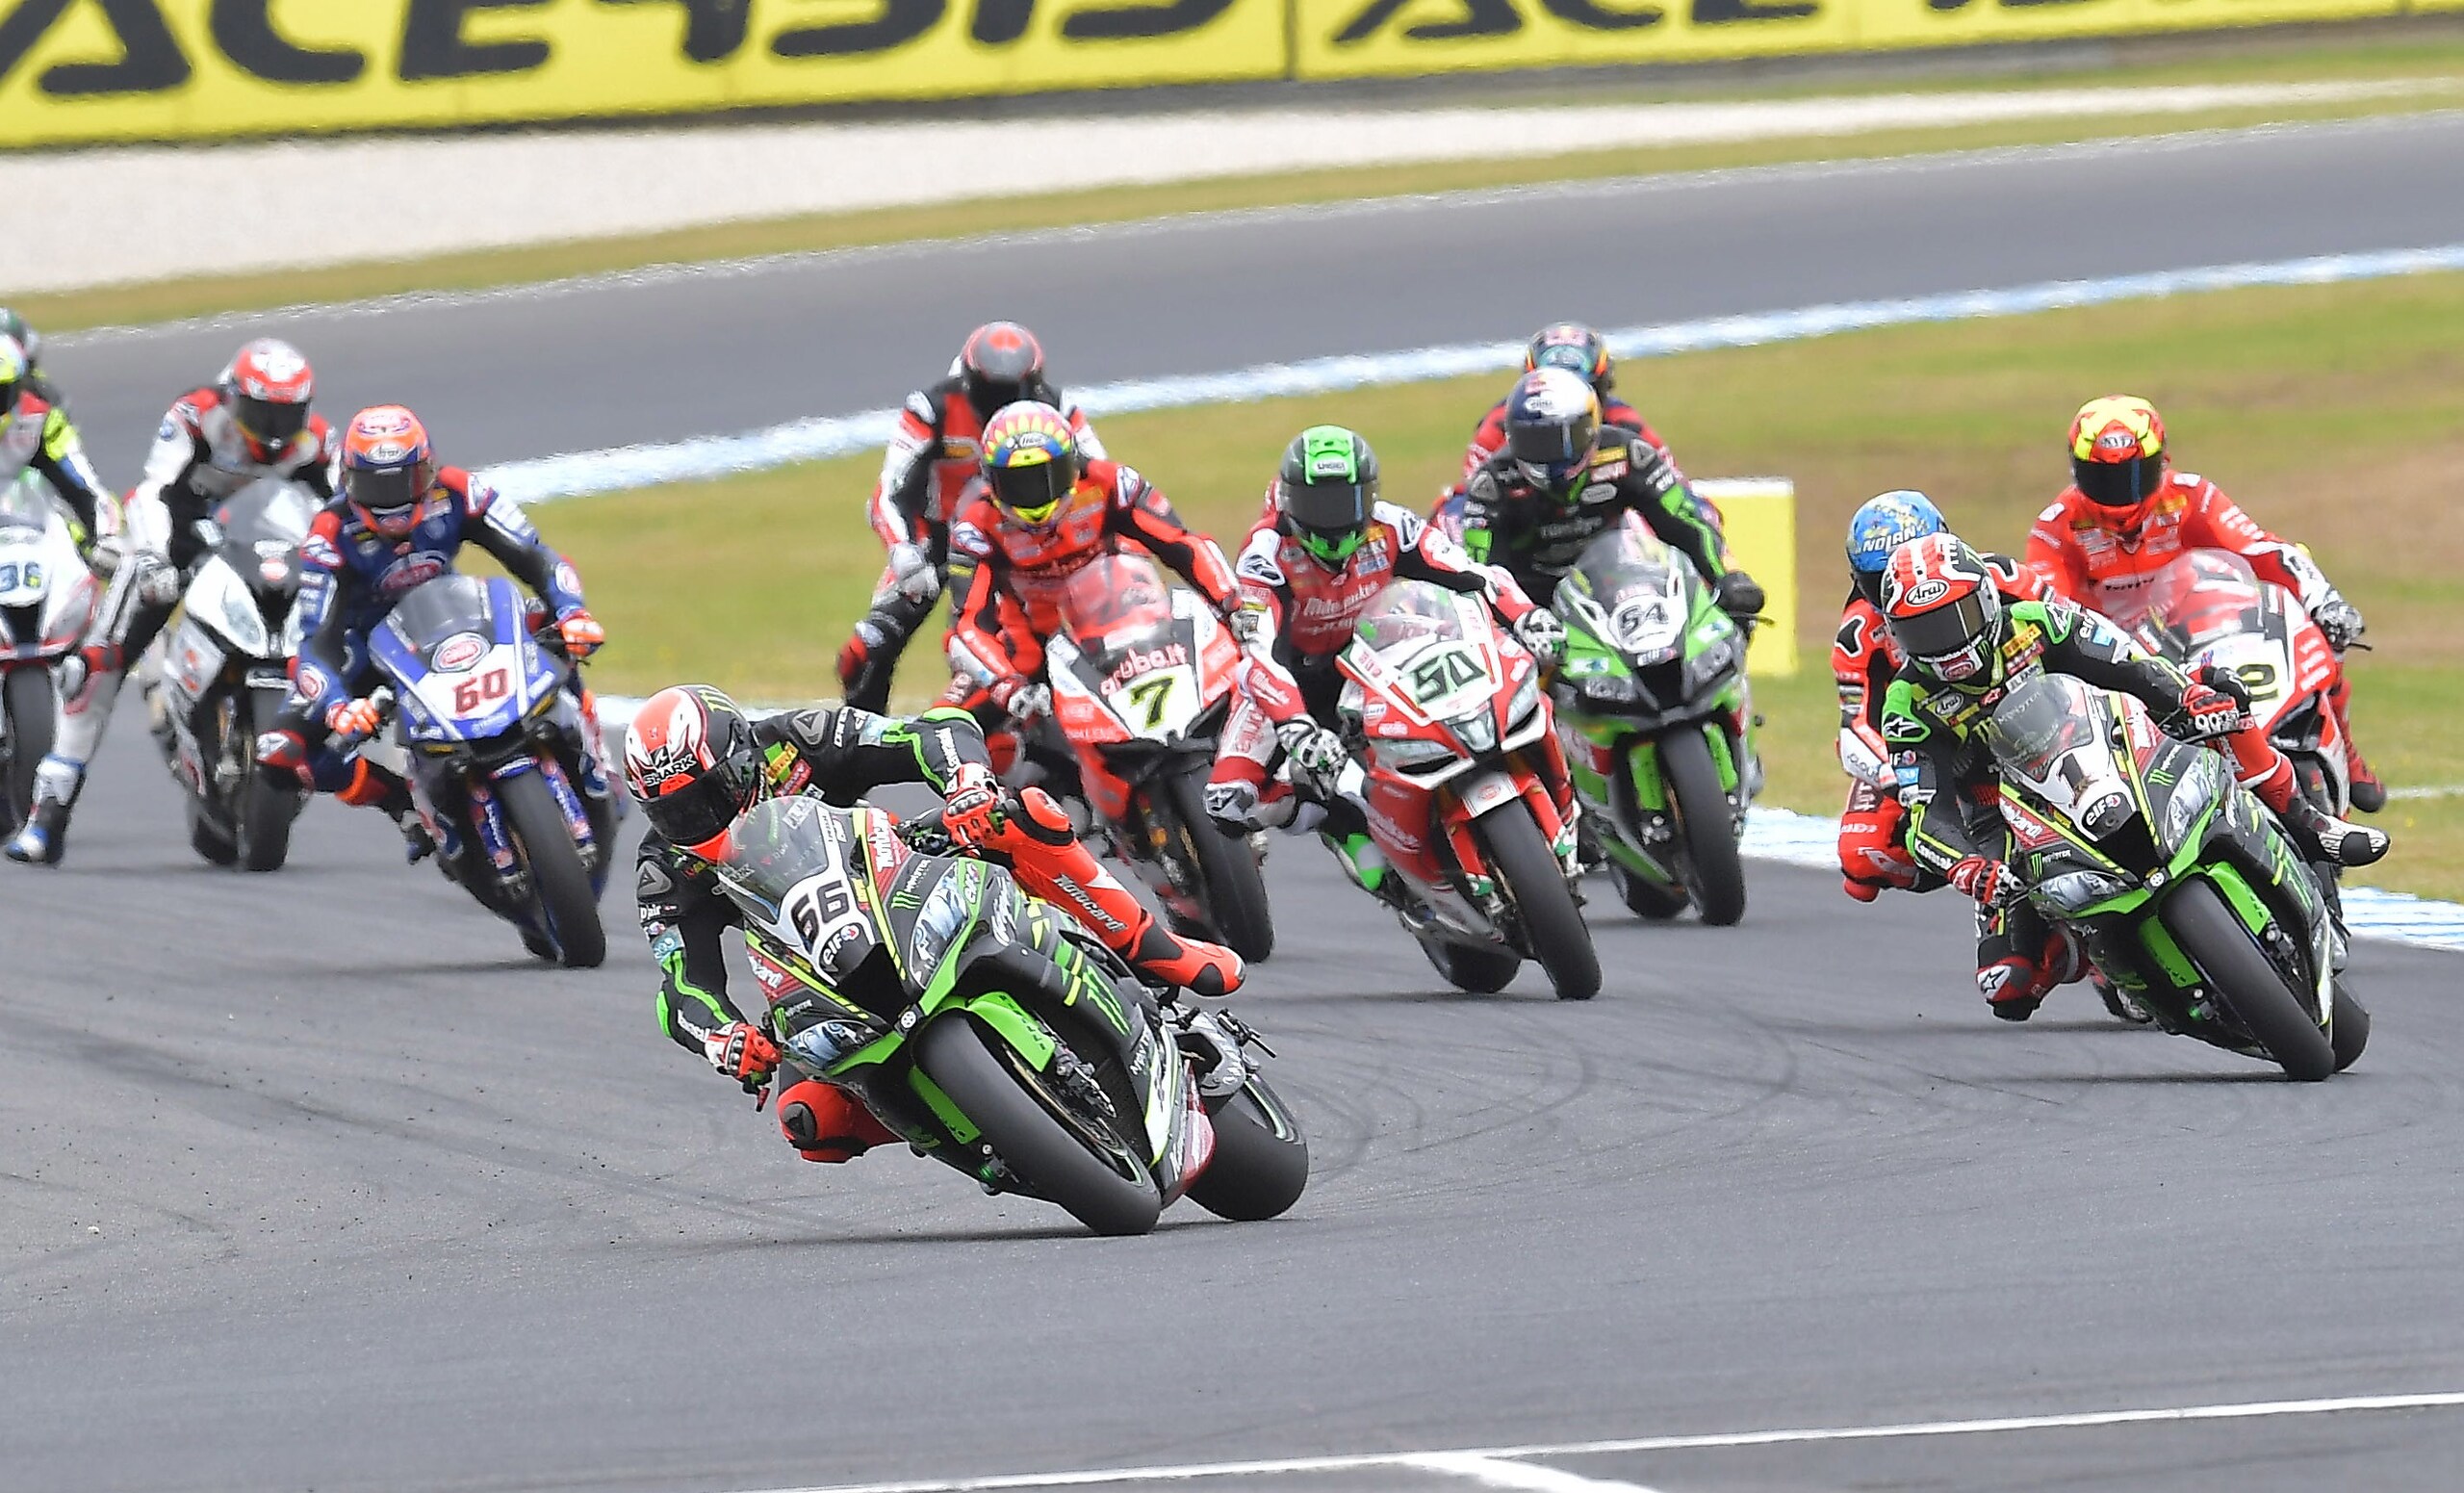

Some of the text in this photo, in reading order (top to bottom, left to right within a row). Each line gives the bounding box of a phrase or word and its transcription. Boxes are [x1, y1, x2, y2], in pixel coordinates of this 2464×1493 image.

[1862, 525, 1918, 553] NOLAN
[1911, 580, 1942, 603] Arai
[453, 668, 508, 716] 60
[1415, 650, 1486, 705] 50
[1129, 675, 1176, 730] 7
[643, 753, 698, 787] SHARK
[2085, 801, 2107, 826] elf
[823, 933, 848, 965] elf
